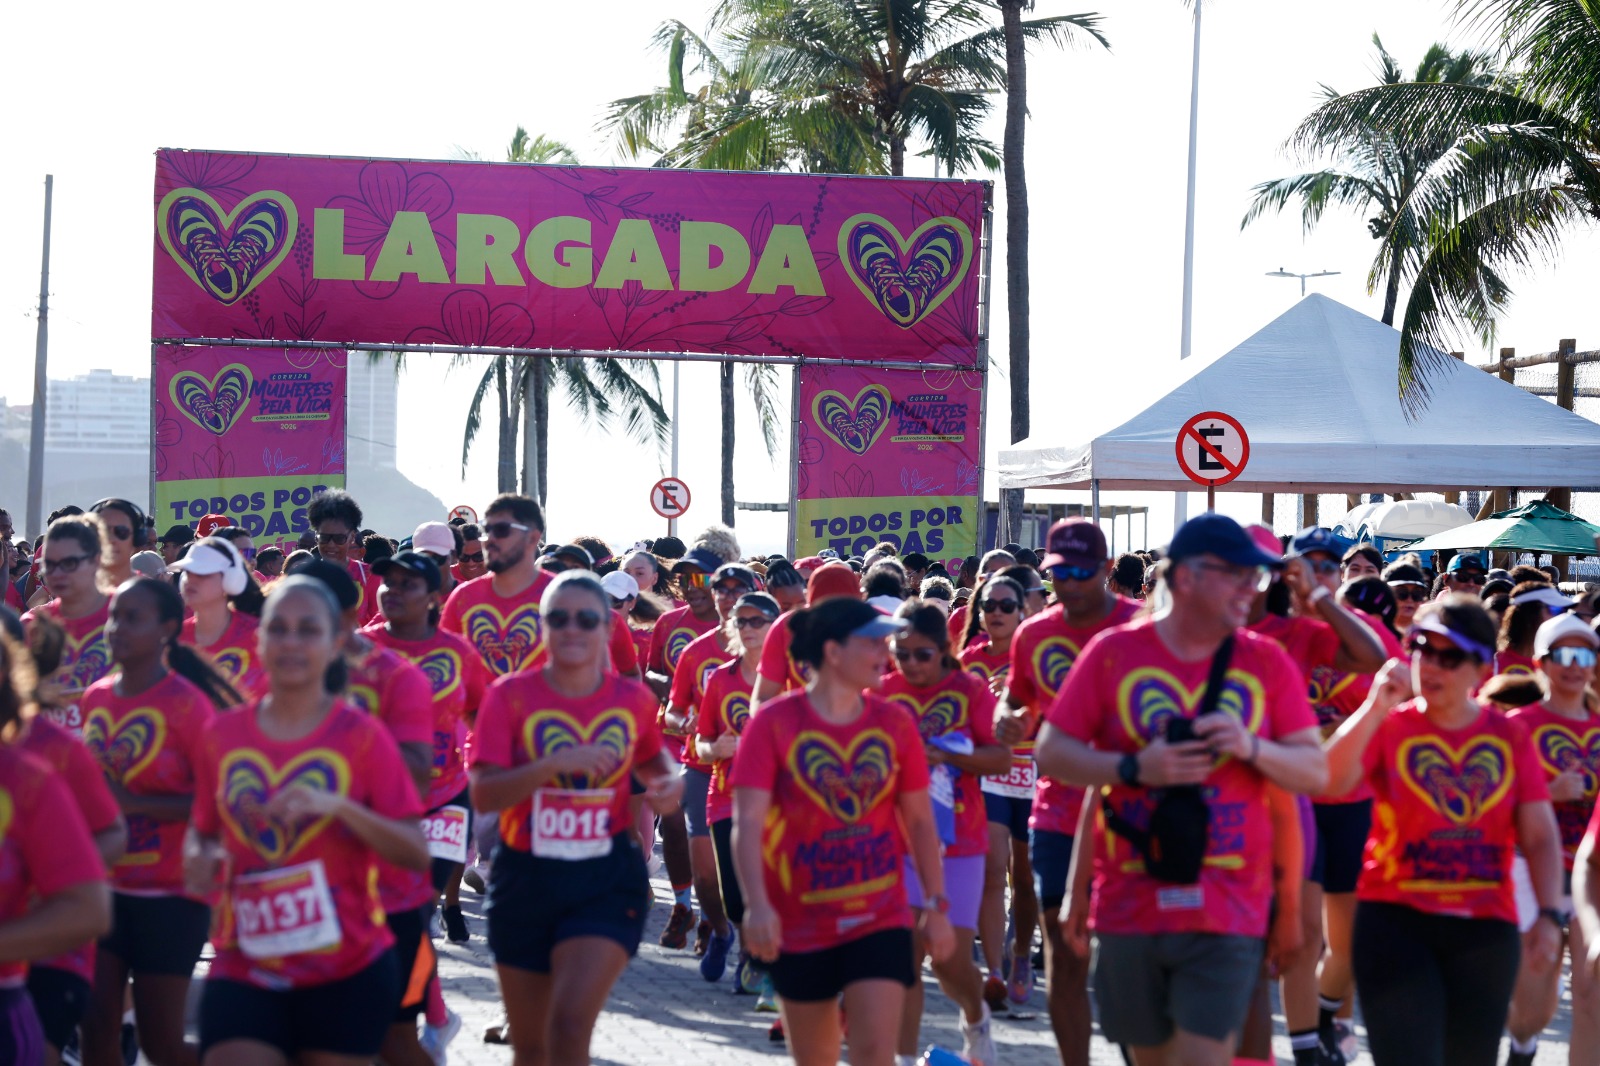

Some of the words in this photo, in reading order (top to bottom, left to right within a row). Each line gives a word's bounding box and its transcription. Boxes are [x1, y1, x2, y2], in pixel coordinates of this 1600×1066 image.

[313, 207, 827, 297] LARGADA
[248, 379, 334, 399] MULHERES
[259, 399, 291, 415] PELA
[296, 397, 331, 413] VIDA
[888, 401, 968, 420] MULHERES
[897, 420, 927, 435] PELA
[932, 419, 966, 434] VIDA
[1199, 428, 1224, 470] E
[170, 492, 265, 520] TODOS
[663, 486, 678, 509] E
[811, 512, 902, 538] TODOS
[910, 506, 963, 529] POR
